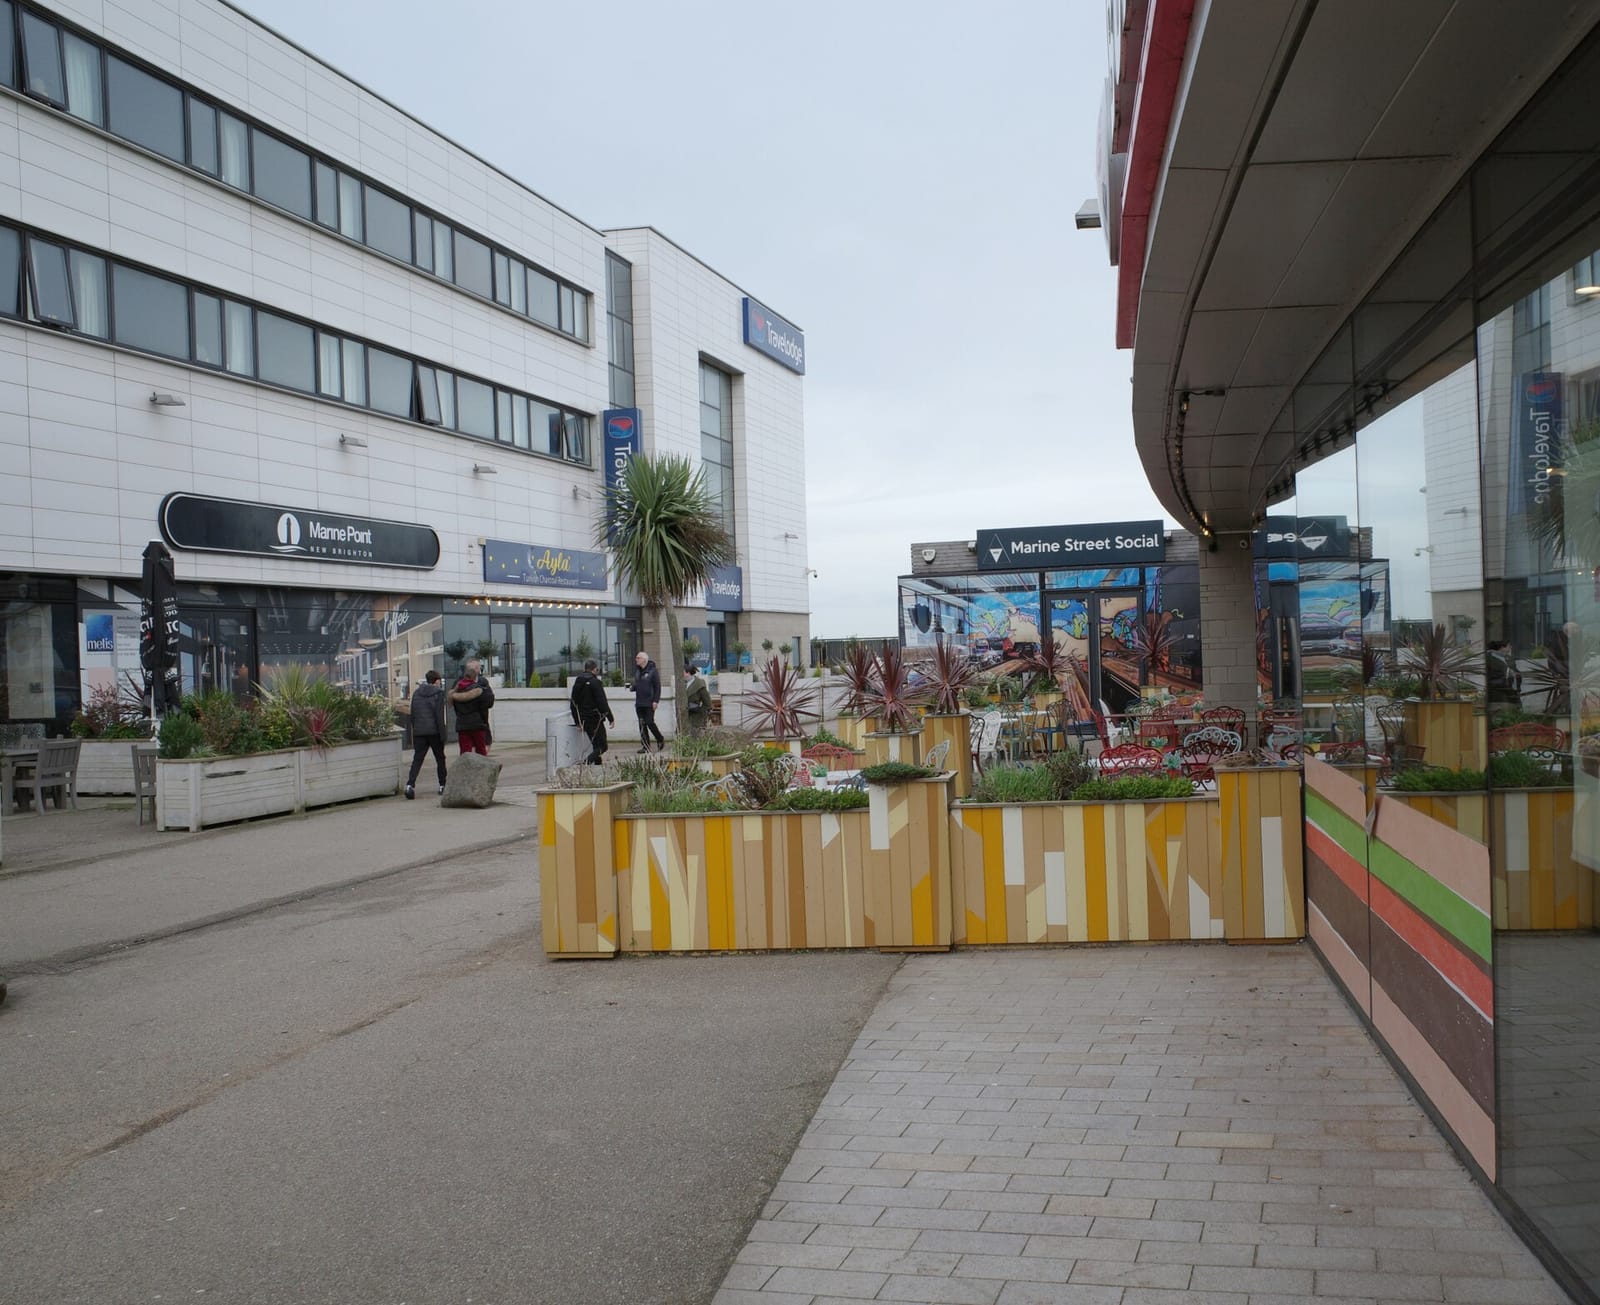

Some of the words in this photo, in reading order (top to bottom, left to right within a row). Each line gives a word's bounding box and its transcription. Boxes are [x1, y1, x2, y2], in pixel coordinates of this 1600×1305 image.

[766, 320, 803, 366] Travelodge
[309, 521, 346, 541] Marine
[347, 526, 372, 544] Point
[309, 545, 327, 553] NEW
[332, 547, 373, 558] BRIGHTON
[1011, 540, 1060, 554] Marine
[1065, 537, 1111, 552] Street
[1115, 534, 1159, 549] Social
[536, 549, 571, 576] Ayla
[711, 578, 741, 599] Travelodge
